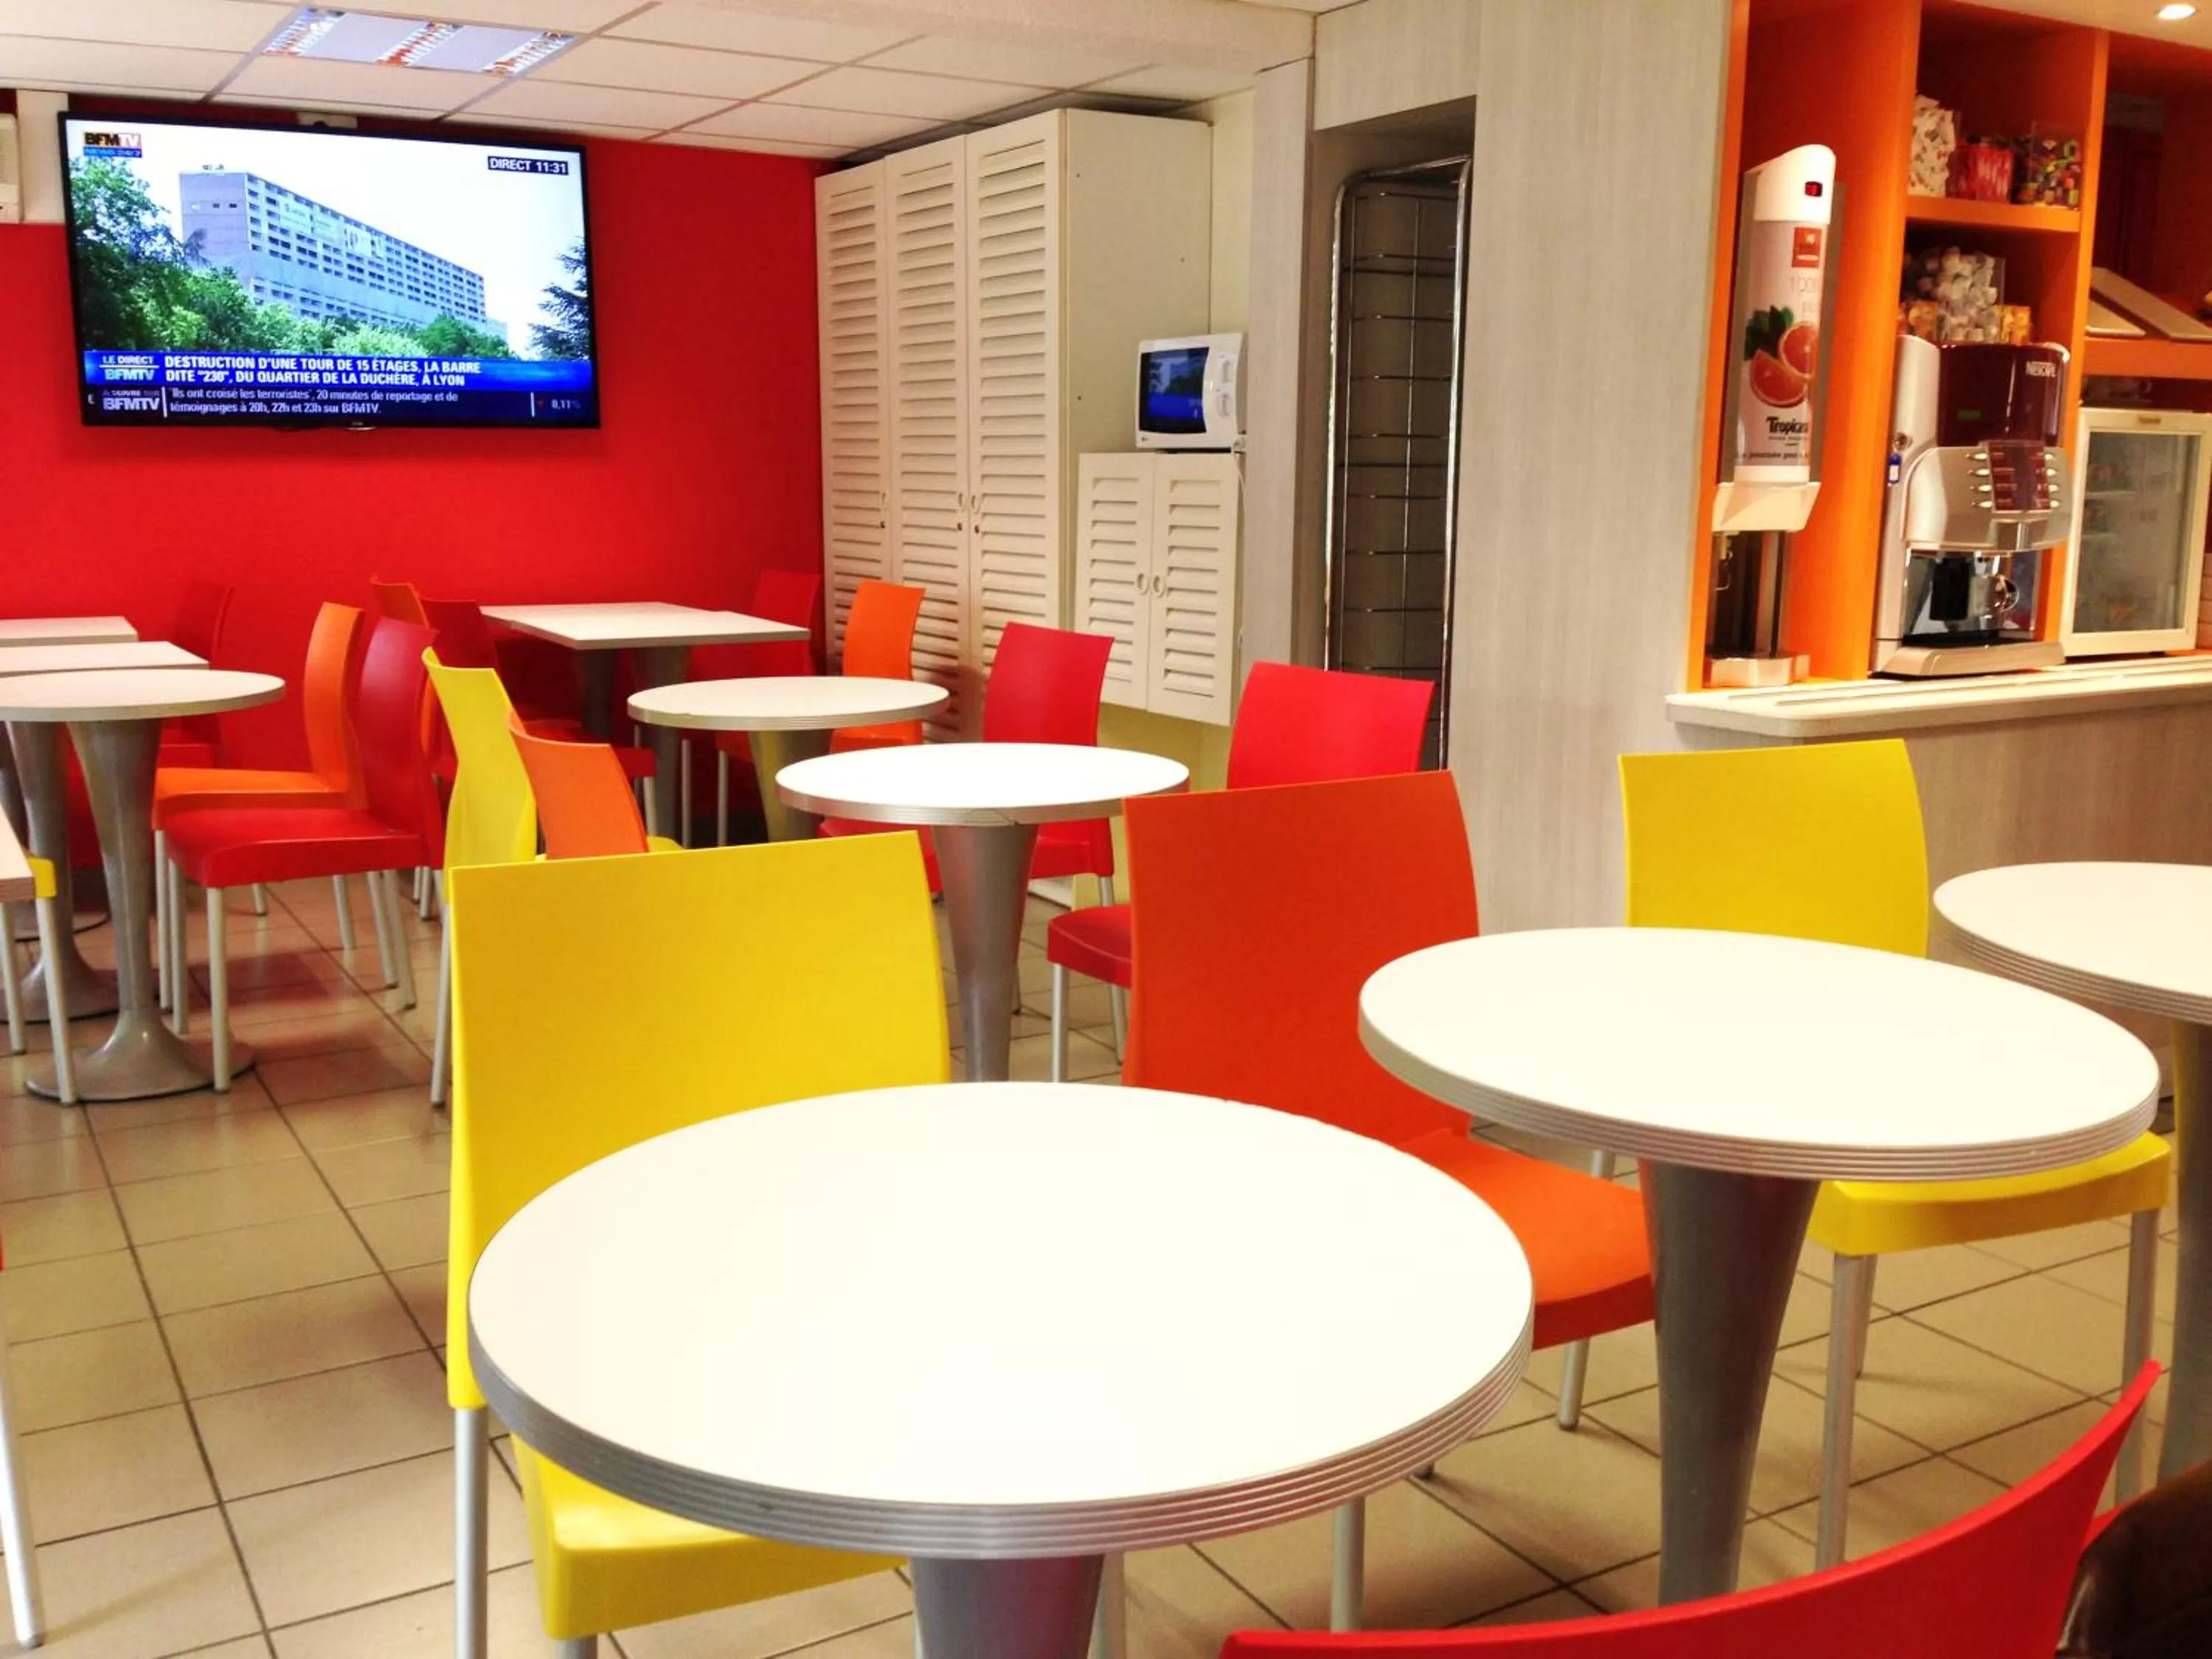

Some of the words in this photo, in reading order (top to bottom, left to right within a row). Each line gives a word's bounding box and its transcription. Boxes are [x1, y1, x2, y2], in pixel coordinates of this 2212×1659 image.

[85, 133, 141, 146] BFMTV
[490, 157, 532, 171] DIRECT
[536, 161, 567, 174] 11:31
[102, 356, 115, 364] LE
[117, 356, 153, 365] DIRECT
[164, 355, 255, 369] DESTRUCTION
[258, 357, 297, 369] D'UNE
[300, 358, 334, 371] TOUR
[336, 359, 353, 371] DE
[356, 359, 369, 371] 15
[424, 361, 440, 373] LA
[442, 361, 481, 375] BARRE
[105, 369, 154, 381] BFMTV
[166, 369, 195, 382] DITE
[236, 370, 254, 383] DU
[257, 371, 320, 384] QUARTIER
[322, 372, 339, 384] DE
[341, 372, 358, 384] LA
[433, 375, 465, 387] LYON
[187, 389, 204, 398] ont
[240, 389, 256, 399] les
[316, 389, 328, 400] 20
[330, 390, 369, 400] minutes
[371, 390, 384, 400] de
[386, 392, 433, 403] reportage
[434, 392, 445, 401] et
[446, 392, 459, 402] de
[103, 398, 160, 410] BFMTV
[170, 402, 237, 414] témoignages
[271, 402, 290, 413] 22h
[291, 403, 302, 413] et
[304, 402, 322, 413] 23h
[323, 405, 338, 413] sur
